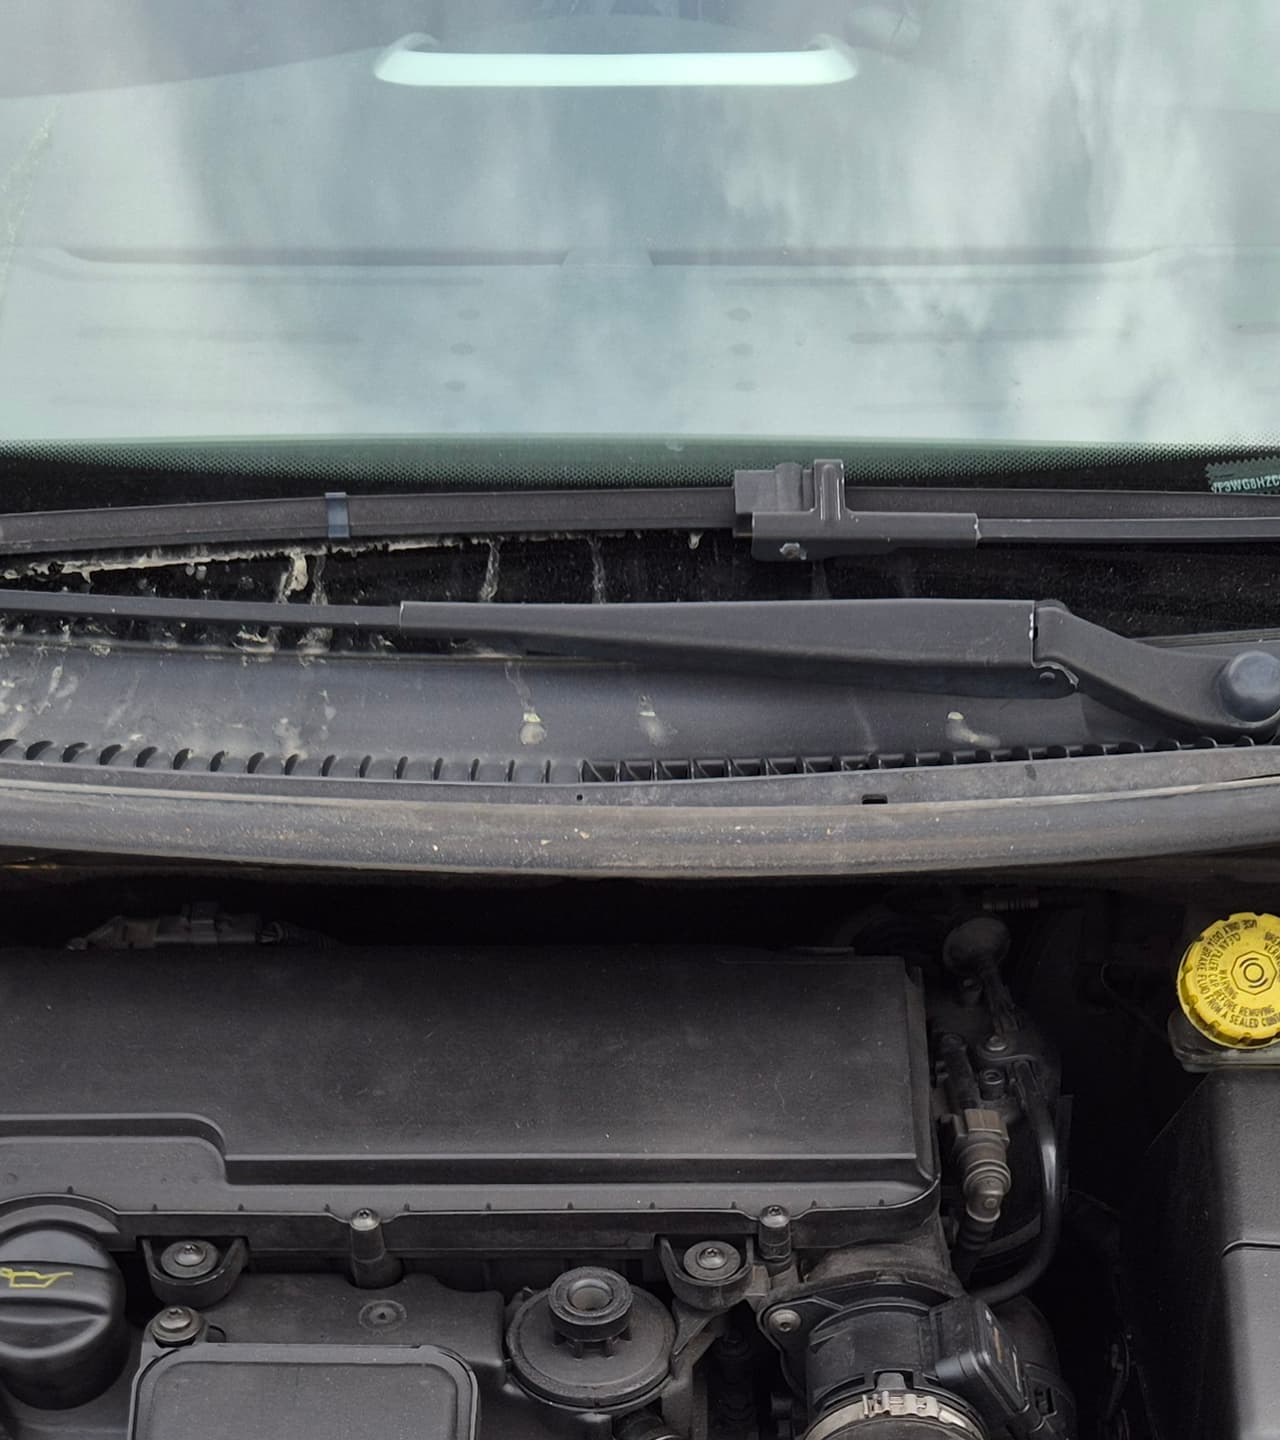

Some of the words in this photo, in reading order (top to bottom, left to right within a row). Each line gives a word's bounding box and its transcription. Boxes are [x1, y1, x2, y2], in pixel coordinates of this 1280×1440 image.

[1219, 932, 1241, 951] CLEAN
[1208, 974, 1219, 988] CAP
[1203, 995, 1225, 1015] FROM
[1229, 1014, 1259, 1028] SEALED
